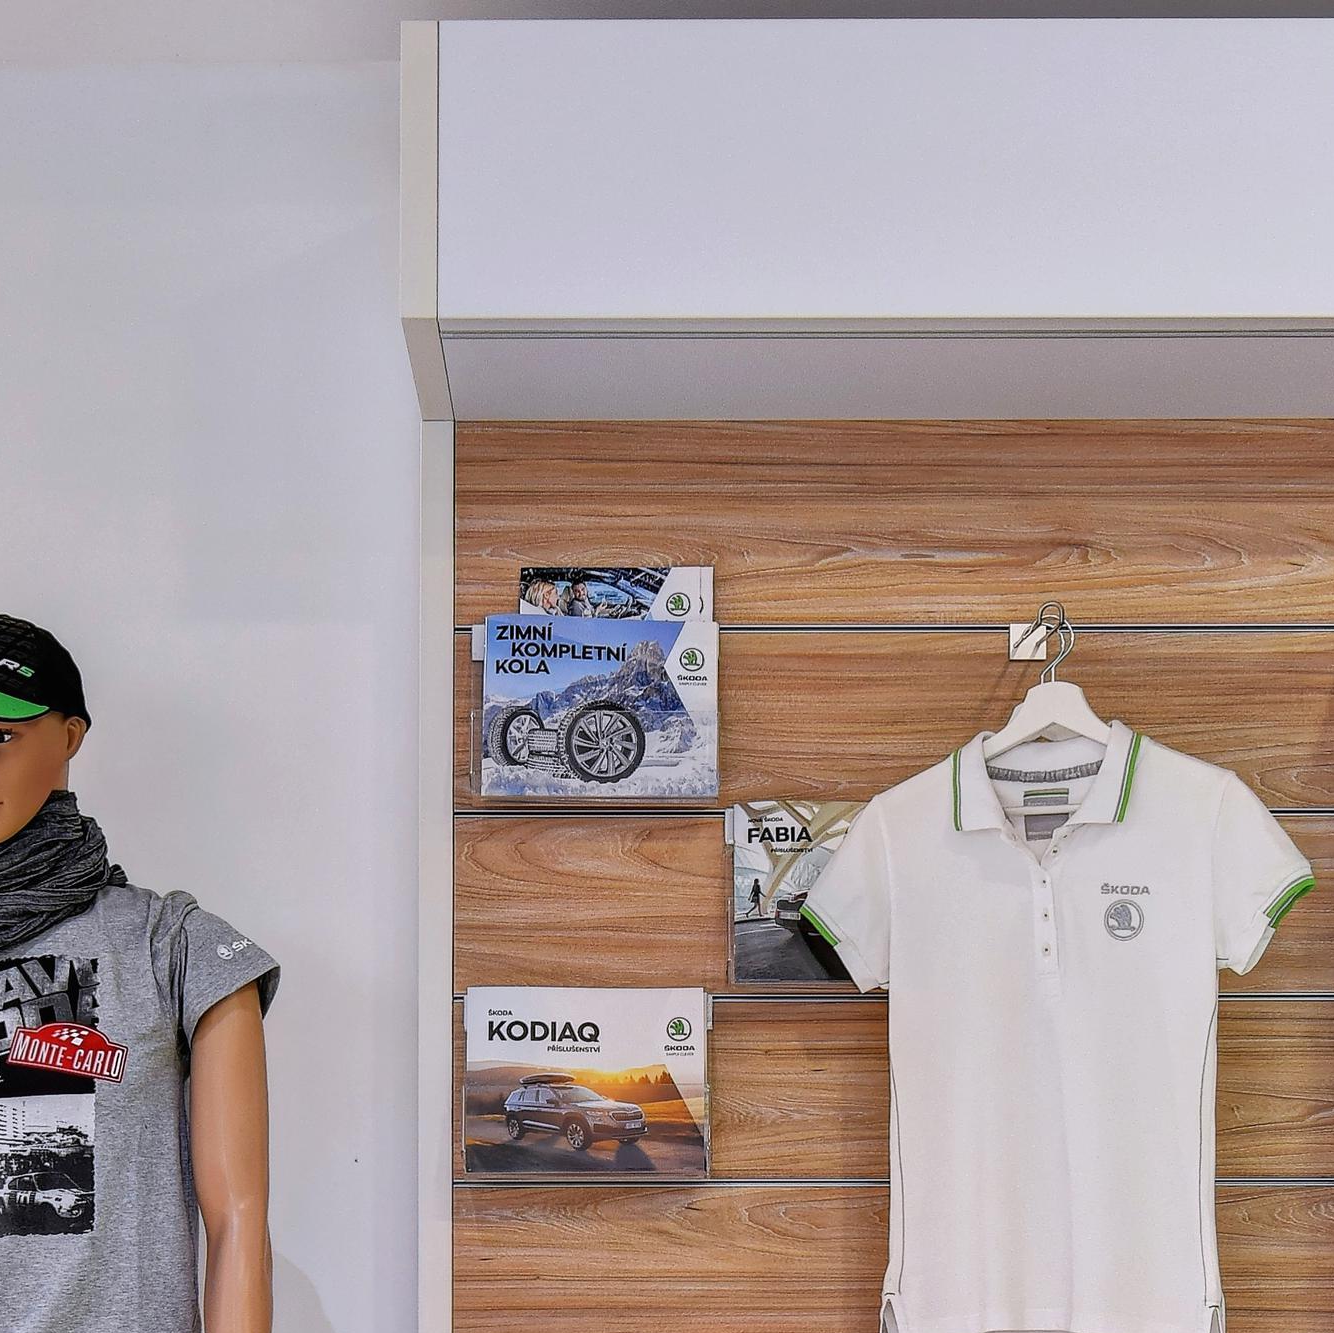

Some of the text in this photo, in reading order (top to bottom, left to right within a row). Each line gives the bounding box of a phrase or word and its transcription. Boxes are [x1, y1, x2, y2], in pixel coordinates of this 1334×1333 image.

[496, 623, 553, 641] ZIMNÍ
[511, 643, 627, 662] KOMPLETNÍ
[495, 659, 550, 675] KOLA
[748, 826, 813, 843] FABIA
[1100, 882, 1151, 896] ŠKODA
[488, 1021, 600, 1043] KODIAQ
[12, 1032, 123, 1077] MONTE-CARLO
[547, 1045, 601, 1053] PŘÍSLUŠENSTVÍ
